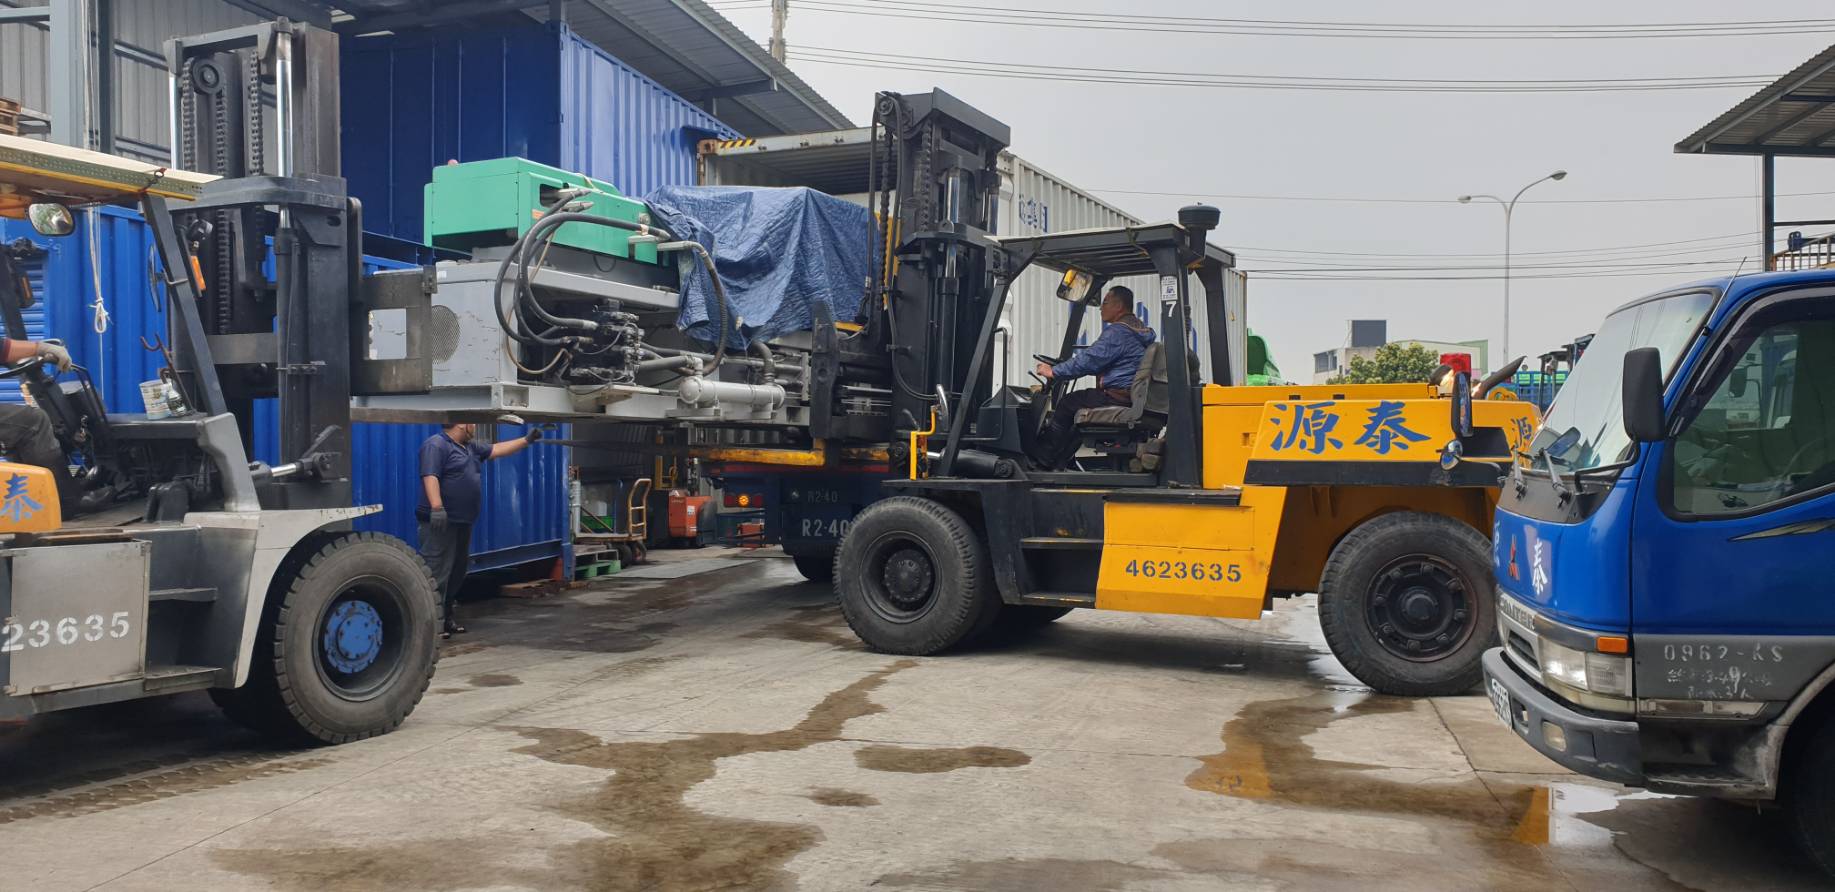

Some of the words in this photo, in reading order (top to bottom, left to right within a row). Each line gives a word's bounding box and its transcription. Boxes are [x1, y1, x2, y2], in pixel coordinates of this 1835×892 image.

[1165, 300, 1177, 318] 7
[1269, 400, 1432, 455] 源泰
[0, 472, 45, 522] 泰
[1125, 559, 1242, 582] 4623635
[1, 611, 130, 652] 23635
